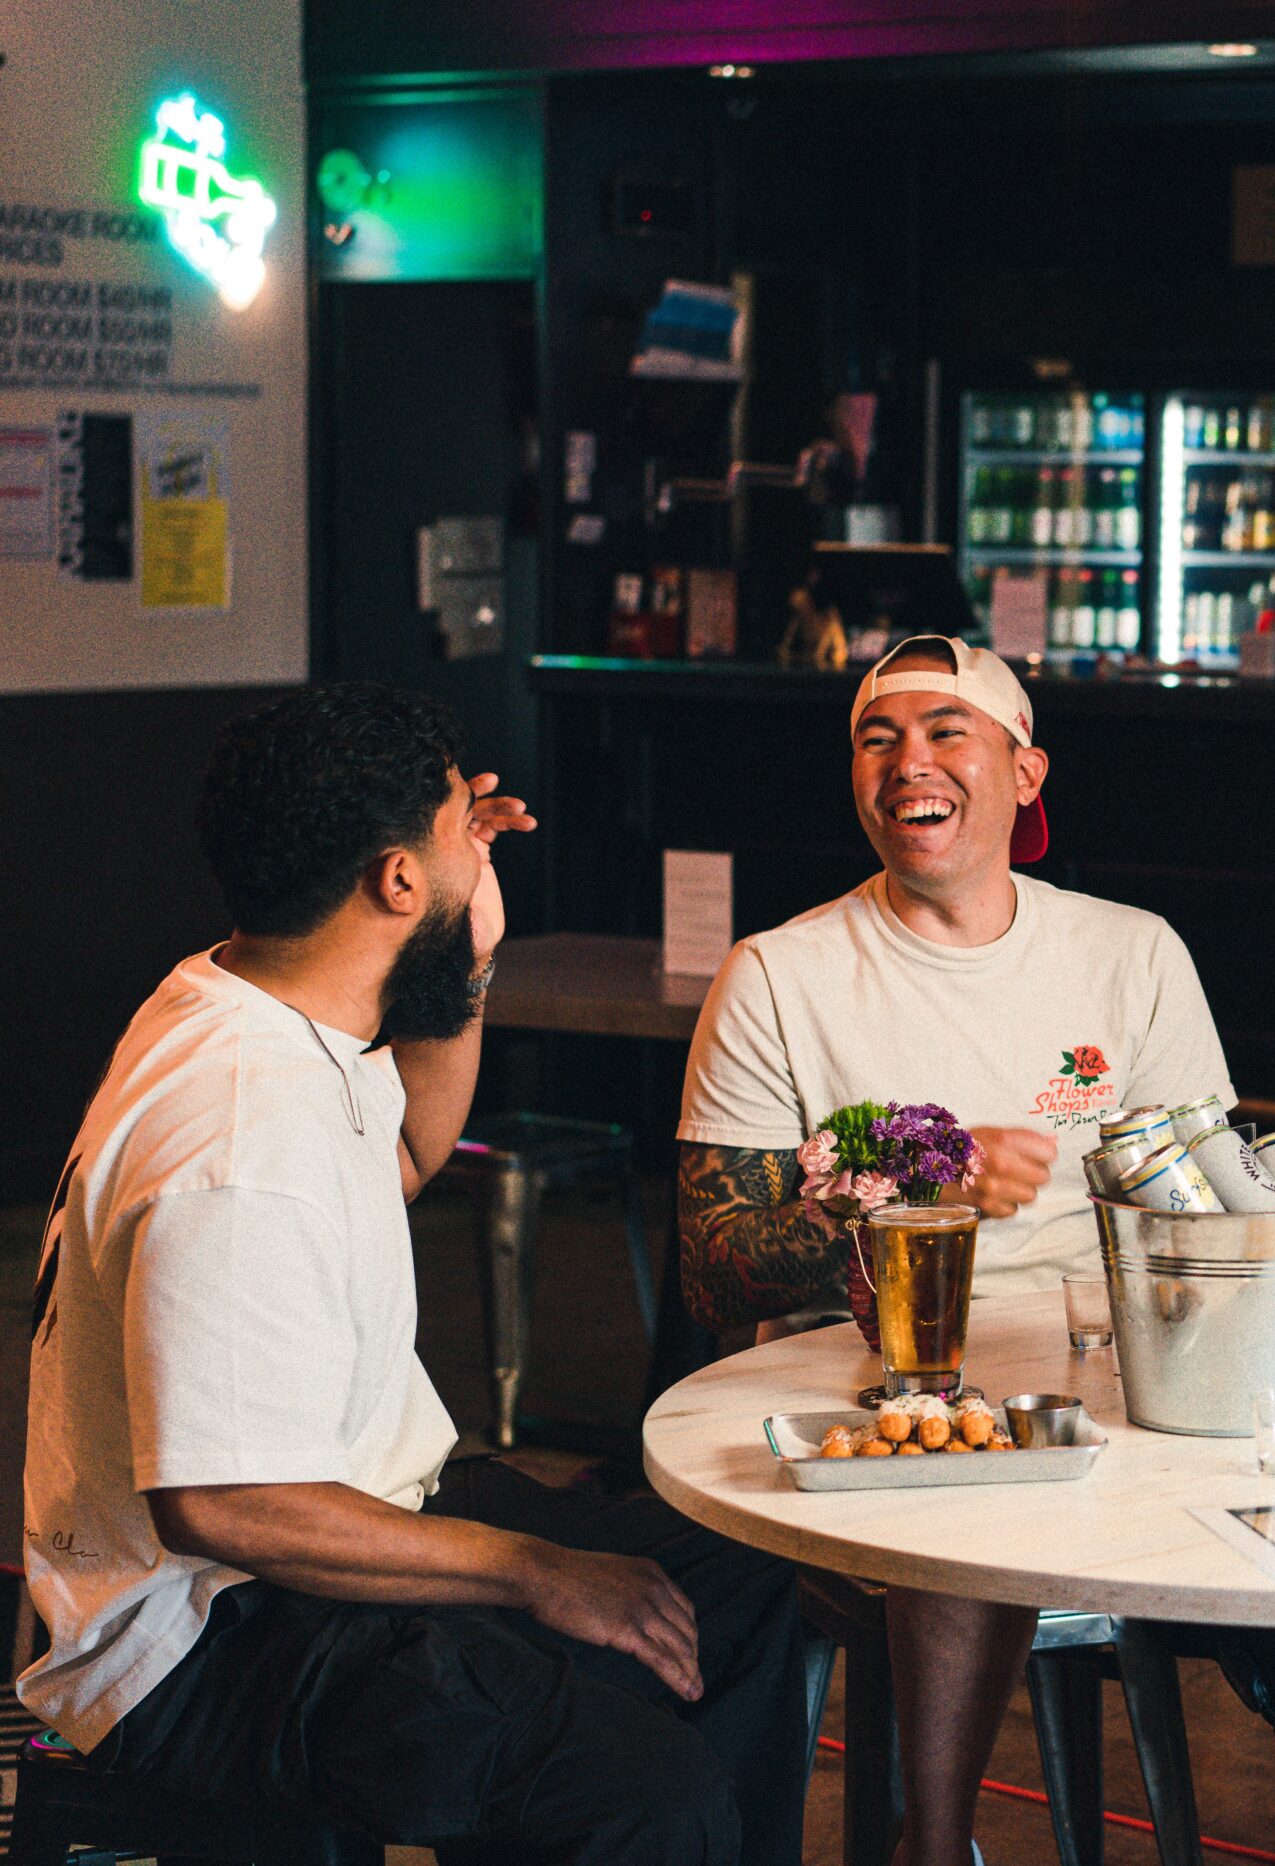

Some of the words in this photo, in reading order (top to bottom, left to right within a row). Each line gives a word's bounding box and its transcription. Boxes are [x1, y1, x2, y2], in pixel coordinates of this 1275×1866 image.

[22, 279, 93, 310] ROOM
[23, 312, 93, 342] ROOM
[18, 344, 90, 374] ROOM
[1048, 1079, 1114, 1099] Flower
[1028, 1091, 1089, 1119] Shops
